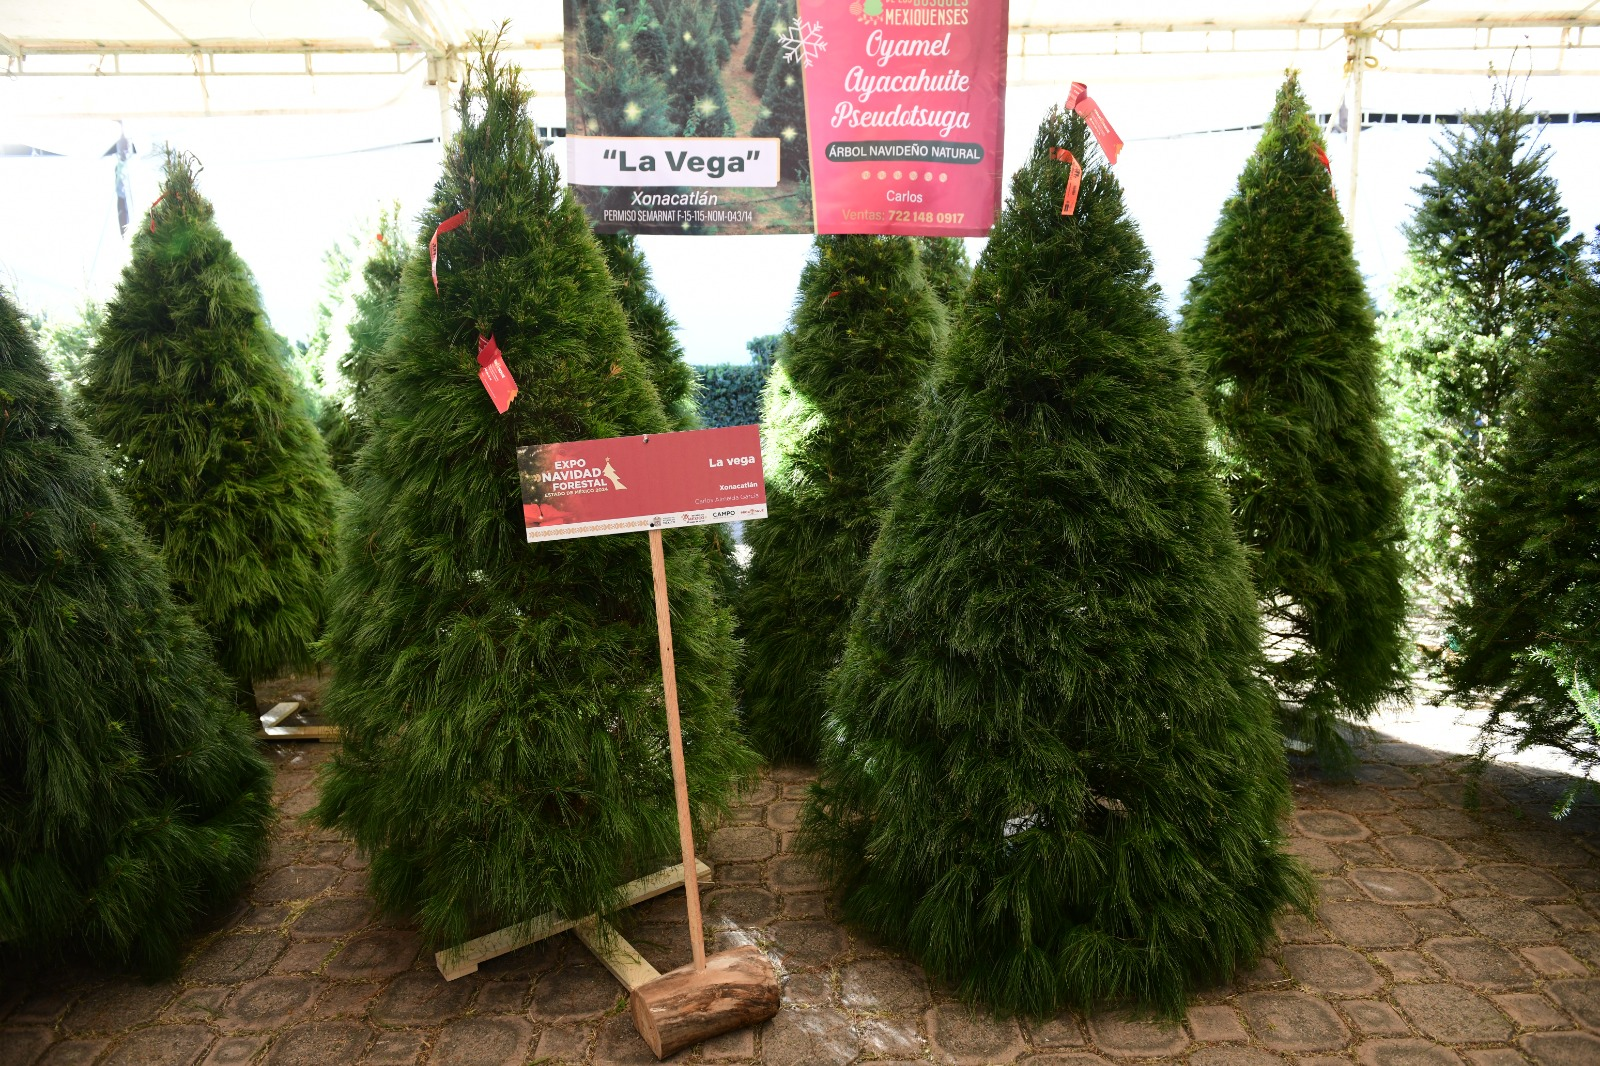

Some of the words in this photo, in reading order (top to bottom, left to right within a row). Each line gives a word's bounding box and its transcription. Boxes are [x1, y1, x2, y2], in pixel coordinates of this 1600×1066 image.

[885, 8, 969, 26] MEXIQUENSES
[866, 29, 951, 67] Oyamel
[844, 66, 970, 103] Ayacahuite
[831, 101, 971, 138] Pseudotsuga
[829, 144, 867, 158] ÁRBOL
[869, 143, 929, 157] NAVIDEÑO
[931, 147, 981, 160] NATURAL
[631, 191, 718, 206] Xonacatlán
[886, 190, 923, 203] Carlos
[603, 209, 637, 222] PERMISO
[637, 209, 676, 222] SEMARNAT
[842, 208, 885, 221] Ventas:
[888, 210, 911, 222] 722
[913, 211, 934, 223] 148
[936, 213, 965, 224] 0917
[554, 458, 587, 470] EXPO
[709, 458, 724, 468] La
[726, 455, 756, 466] vega
[541, 467, 602, 483] NAVIDAD
[552, 478, 608, 492] FORESTAL
[719, 481, 758, 491] Xonacatlán
[712, 510, 736, 518] CAMPO
